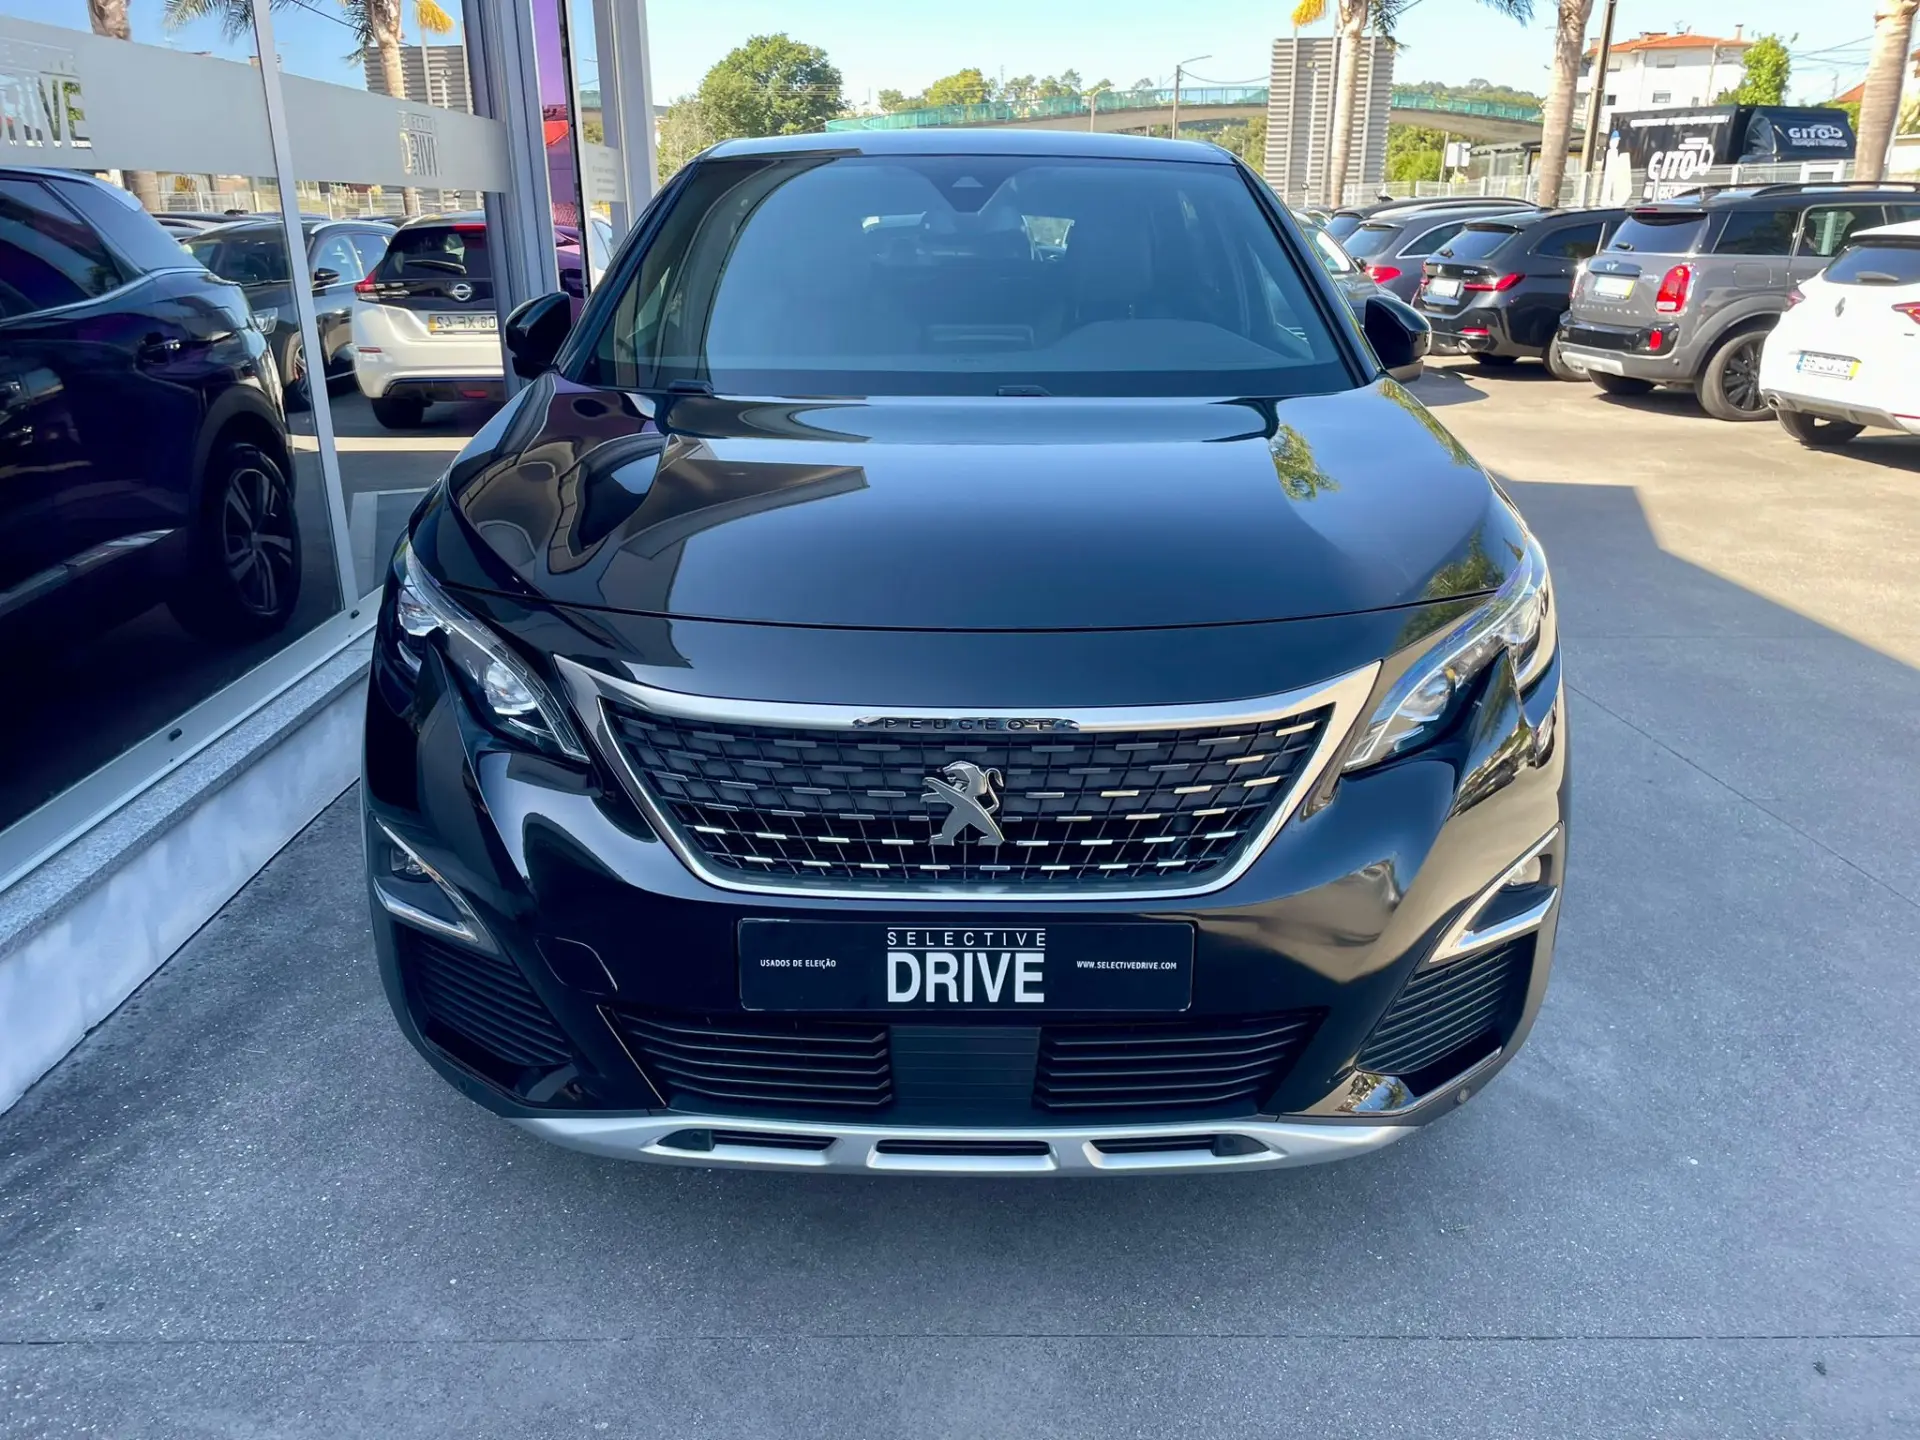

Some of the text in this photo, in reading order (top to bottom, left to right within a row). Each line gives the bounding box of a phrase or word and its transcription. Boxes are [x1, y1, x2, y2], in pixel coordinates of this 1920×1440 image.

[0, 74, 92, 149] RIVE
[884, 718, 1050, 731] PEUGEOT
[887, 931, 1046, 946] SELECTIVE
[760, 957, 837, 970] USADOS DE ELEIÇÃO
[1076, 960, 1177, 970] WWW.SELECTIVEDRIVE.COM
[887, 952, 1045, 1003] DRIVE
